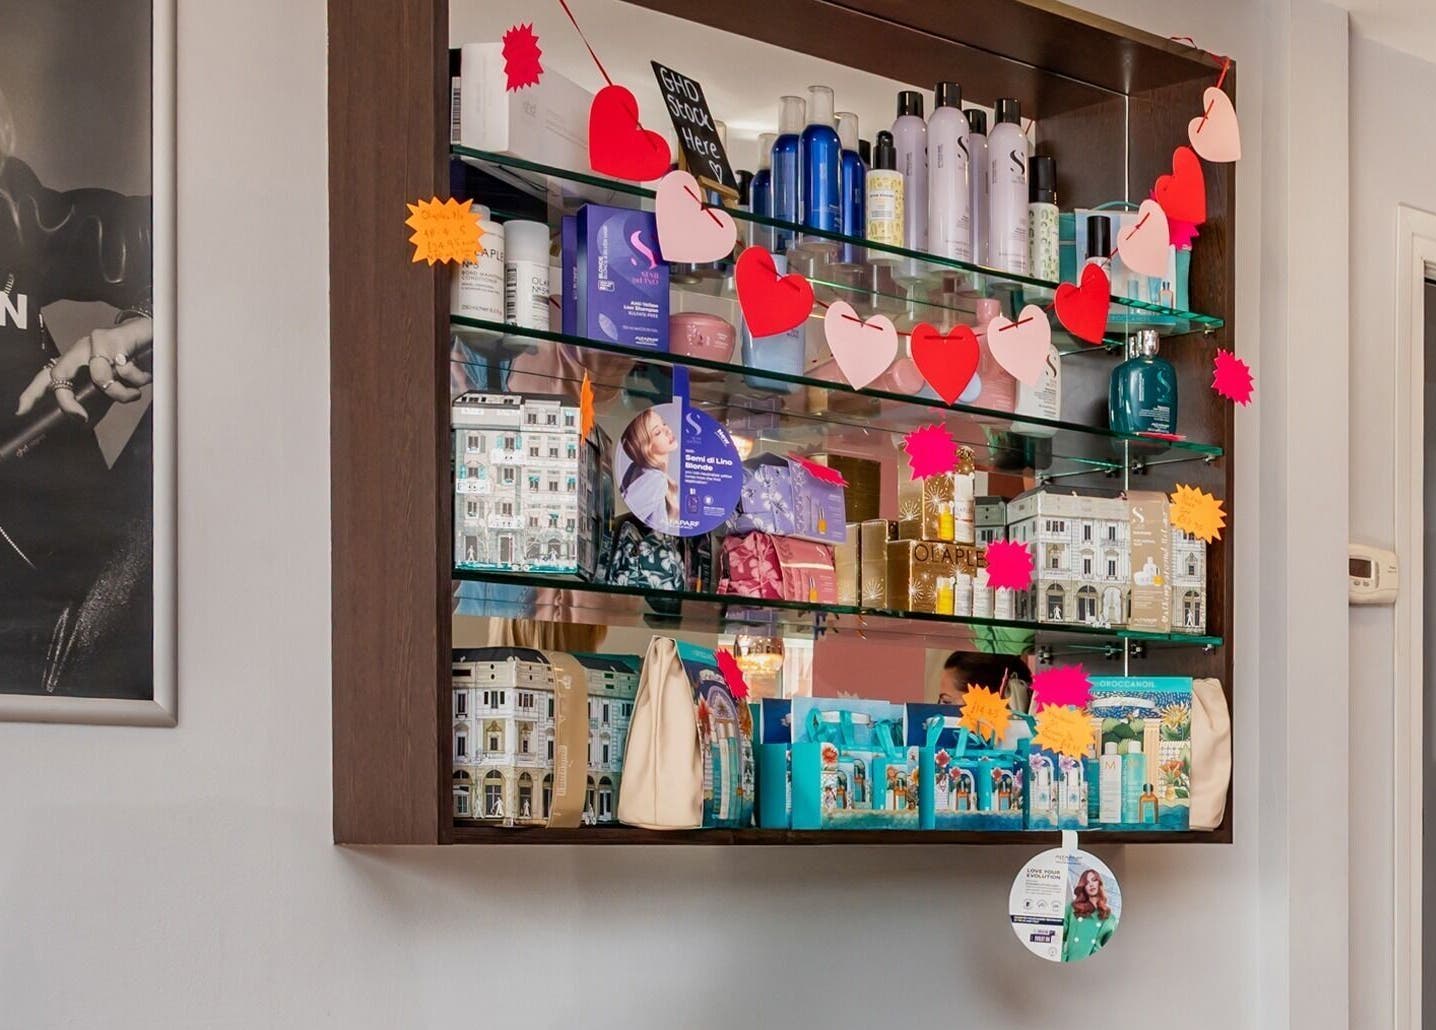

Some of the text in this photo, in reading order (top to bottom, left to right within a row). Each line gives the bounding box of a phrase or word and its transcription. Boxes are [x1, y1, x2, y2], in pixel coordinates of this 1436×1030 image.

[660, 67, 699, 102] GHD
[667, 94, 714, 132] Stock
[682, 127, 720, 159] Here
[716, 428, 730, 445] New
[685, 454, 733, 466] Semi di Lino
[685, 462, 713, 472] Blonde
[914, 543, 989, 568] OLAPLE
